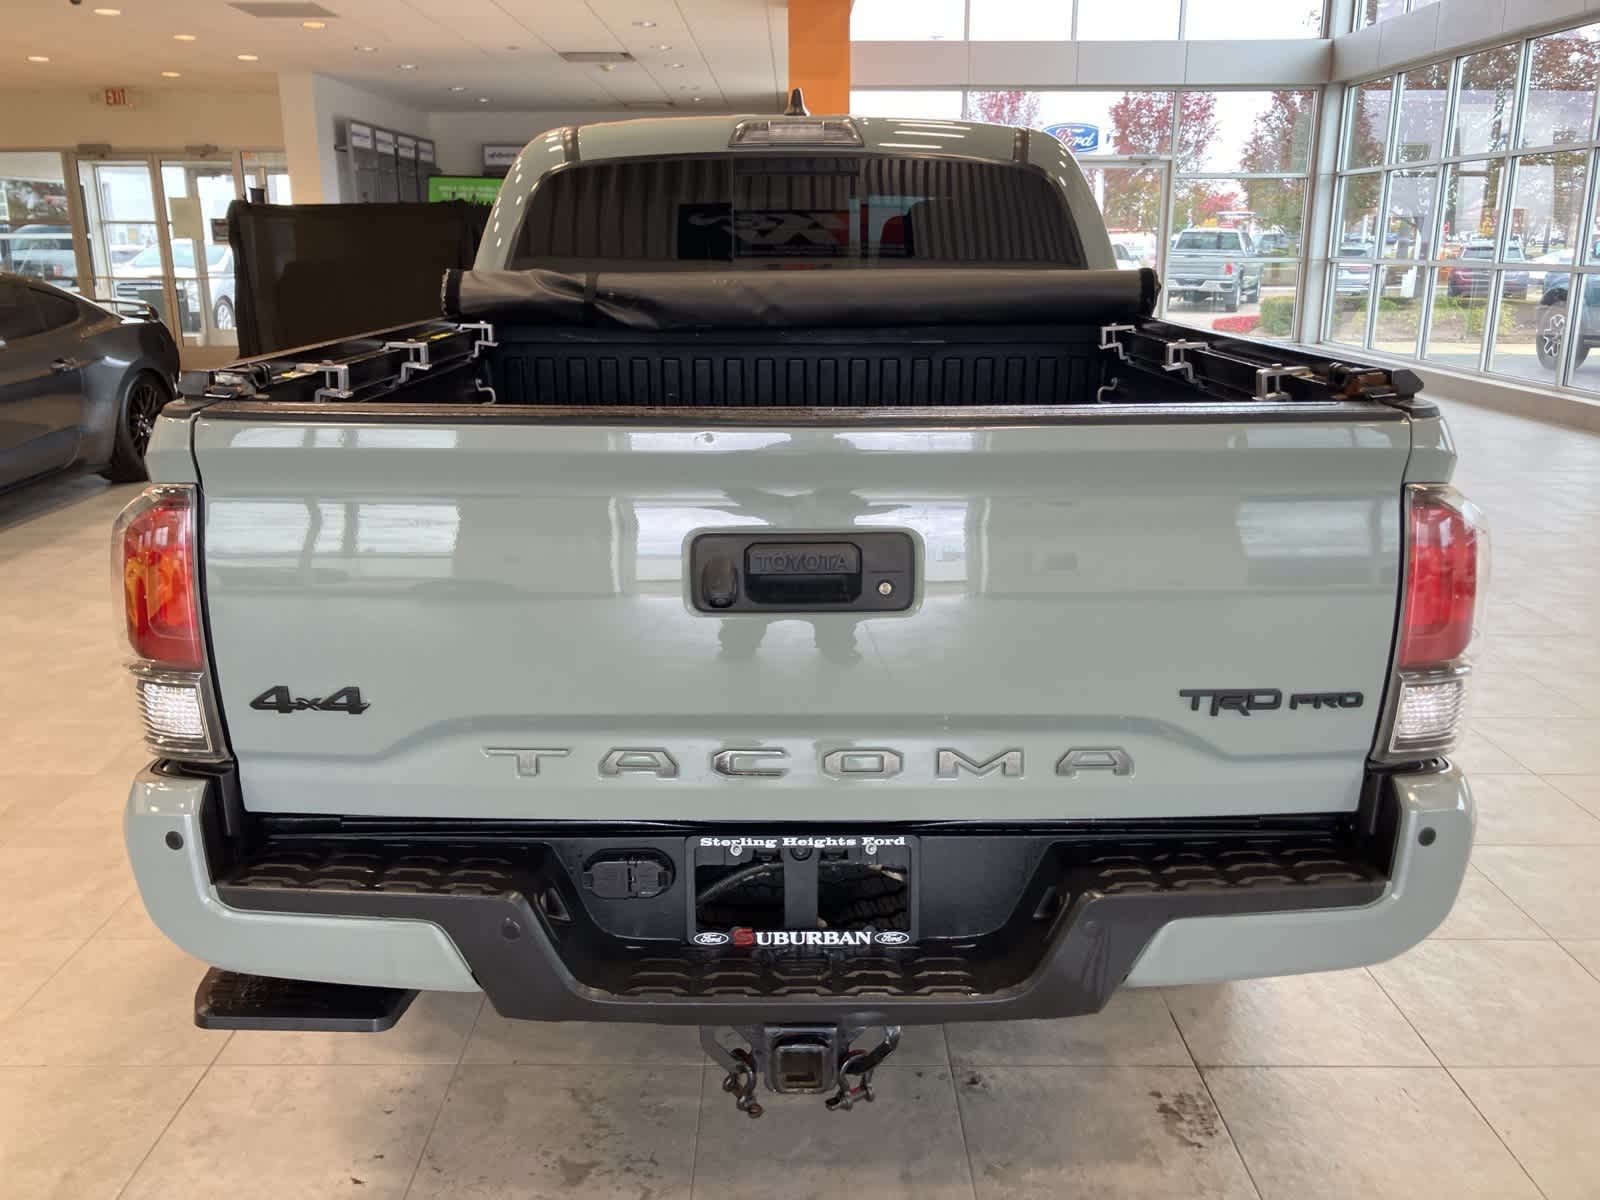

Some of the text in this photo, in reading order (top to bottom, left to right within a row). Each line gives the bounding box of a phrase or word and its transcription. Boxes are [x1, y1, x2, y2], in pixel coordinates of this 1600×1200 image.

[1054, 127, 1097, 148] Ford
[752, 552, 848, 572] TOYOTA
[1179, 688, 1364, 716] TRD PRO
[480, 746, 1135, 778] TACOMA
[700, 836, 905, 849] Sterling Heights Ford
[732, 928, 872, 945] SUBURBAN
